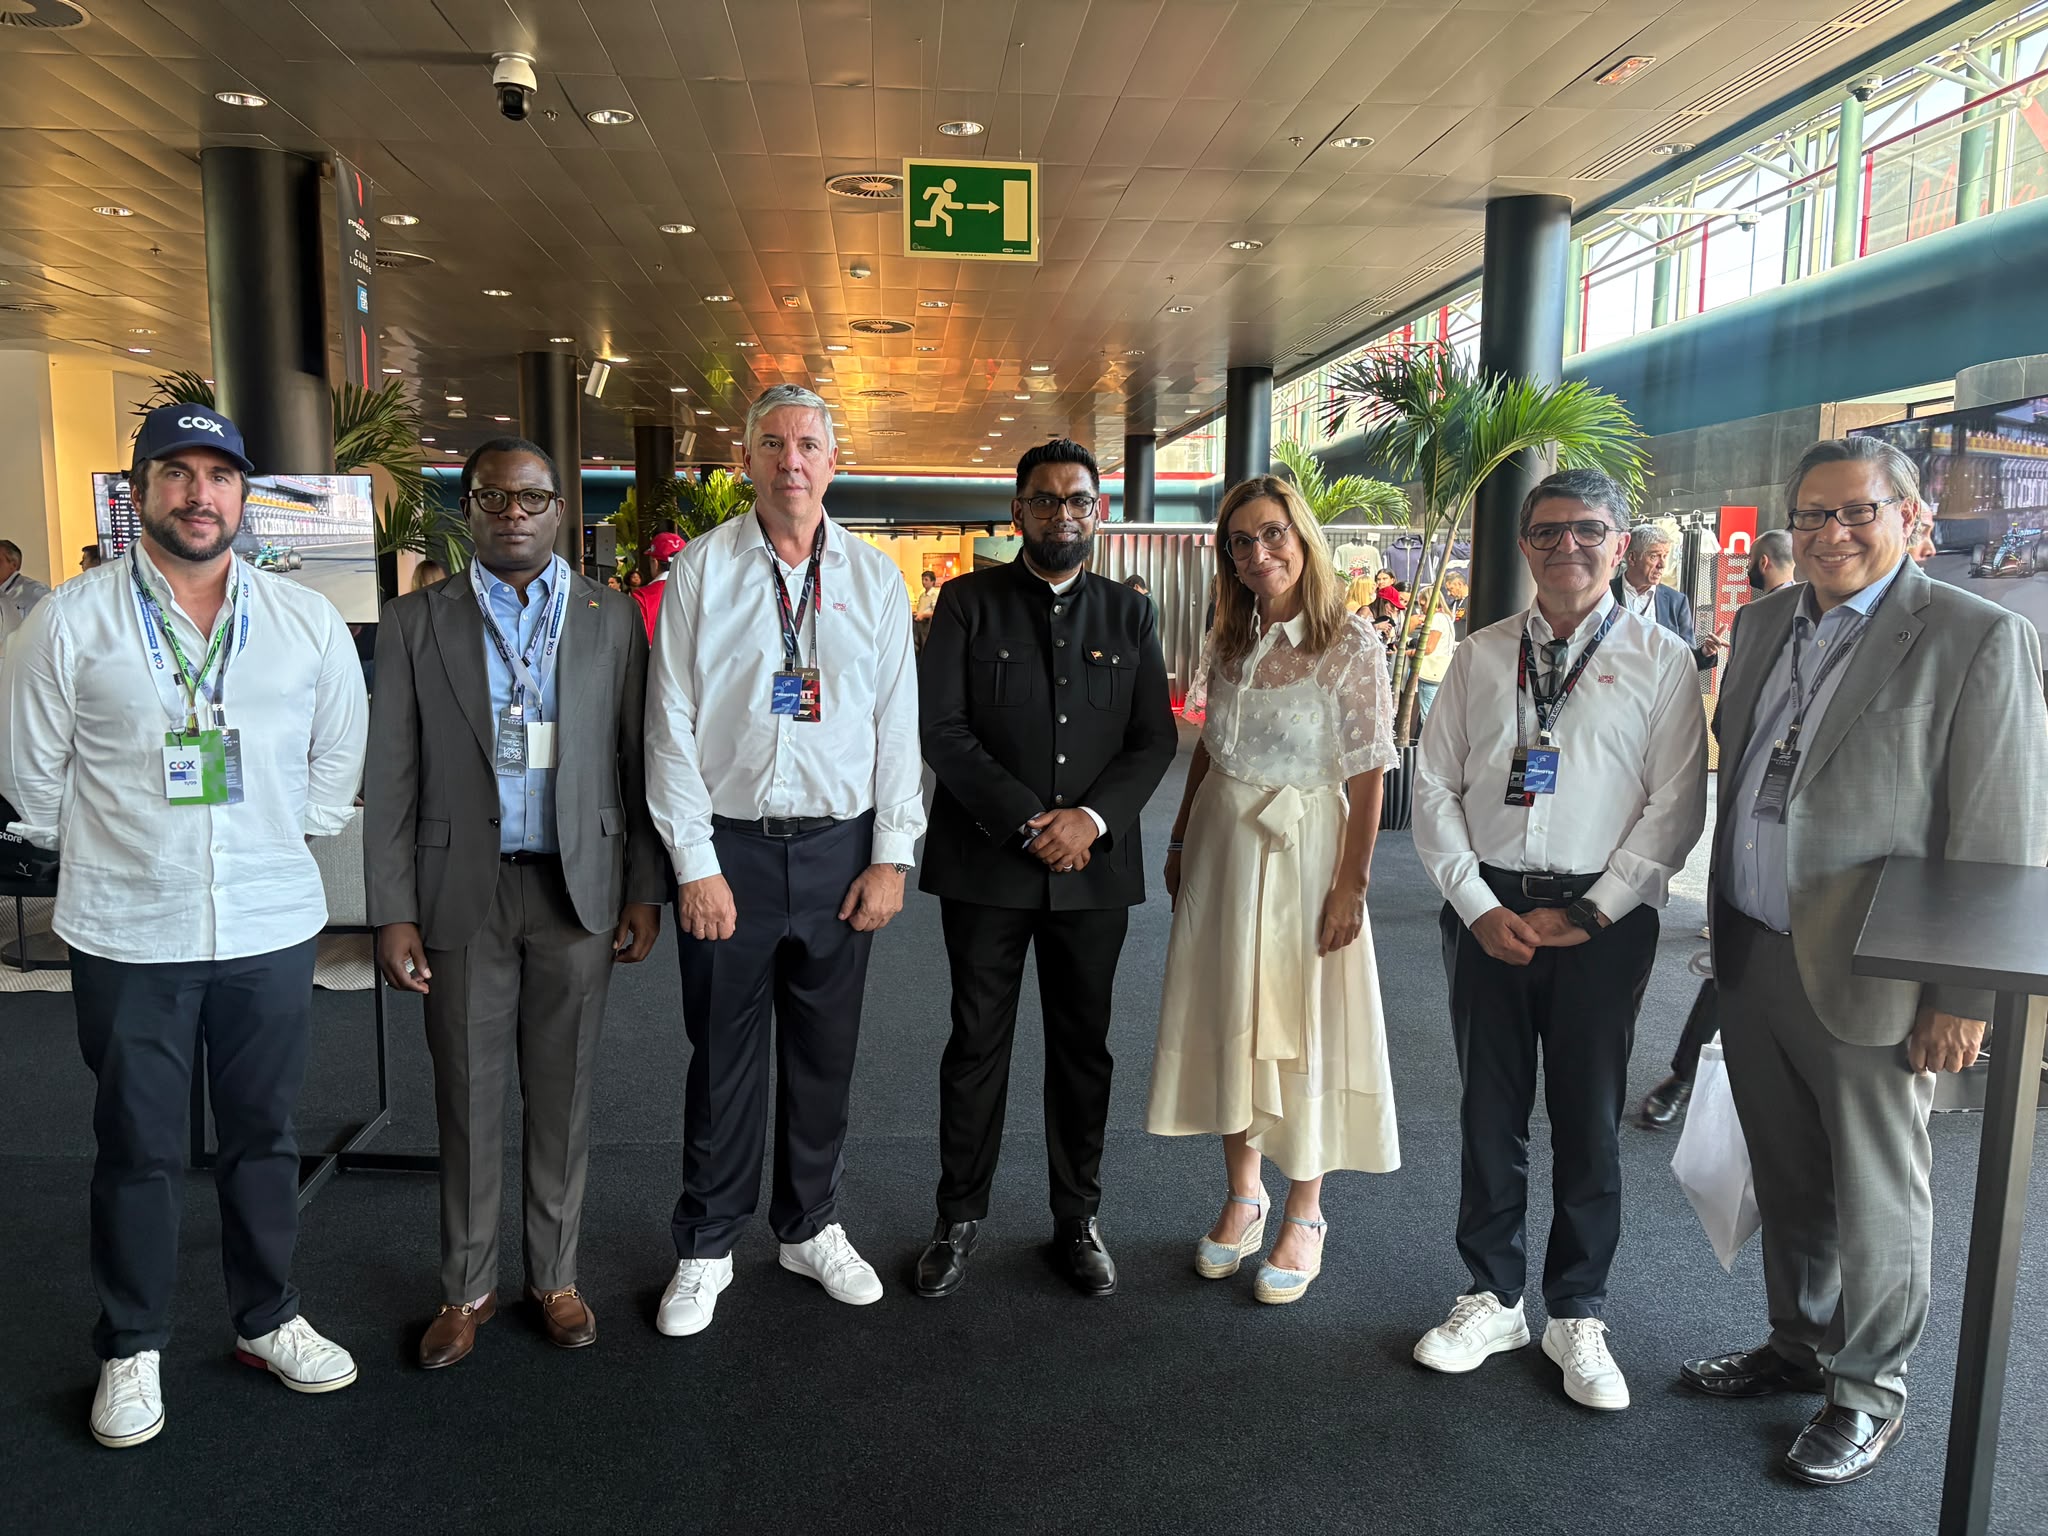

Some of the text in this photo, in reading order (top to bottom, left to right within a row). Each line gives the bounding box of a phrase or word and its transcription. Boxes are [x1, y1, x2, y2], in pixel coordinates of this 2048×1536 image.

[354, 249, 368, 263] CLUB
[349, 256, 372, 275] LOUNGE
[178, 416, 225, 438] COX
[546, 641, 555, 656] COX
[152, 651, 164, 670] COX
[169, 760, 196, 770] COX
